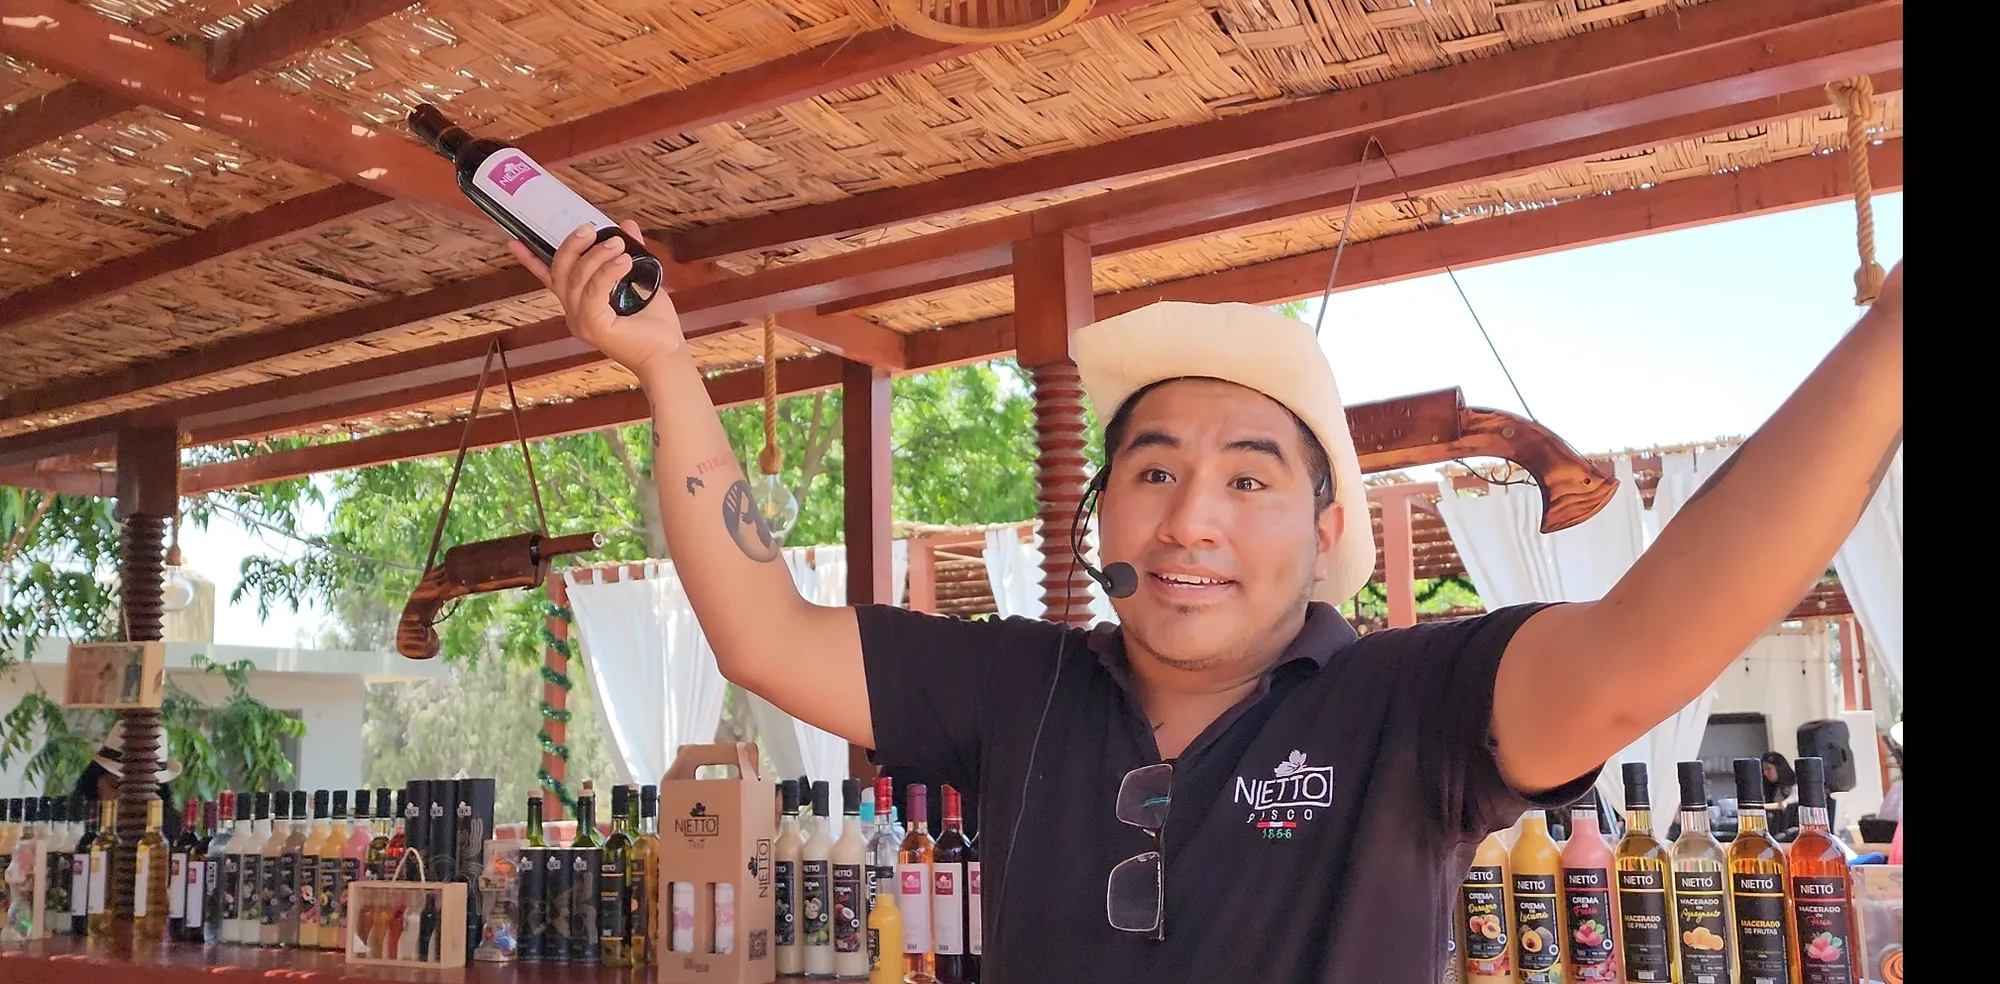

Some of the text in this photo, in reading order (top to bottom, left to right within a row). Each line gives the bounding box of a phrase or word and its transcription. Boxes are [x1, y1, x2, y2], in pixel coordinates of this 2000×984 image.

[1234, 772, 1329, 810] NIETTO
[1246, 809, 1313, 823] PISCO
[674, 817, 718, 836] NIETTO
[757, 840, 770, 898] NIETTO
[1682, 876, 1714, 888] NIETTO
[1741, 878, 1774, 889] NIETTO
[1800, 884, 1835, 895] NIETTO
[1741, 919, 1781, 928] MACERADO
